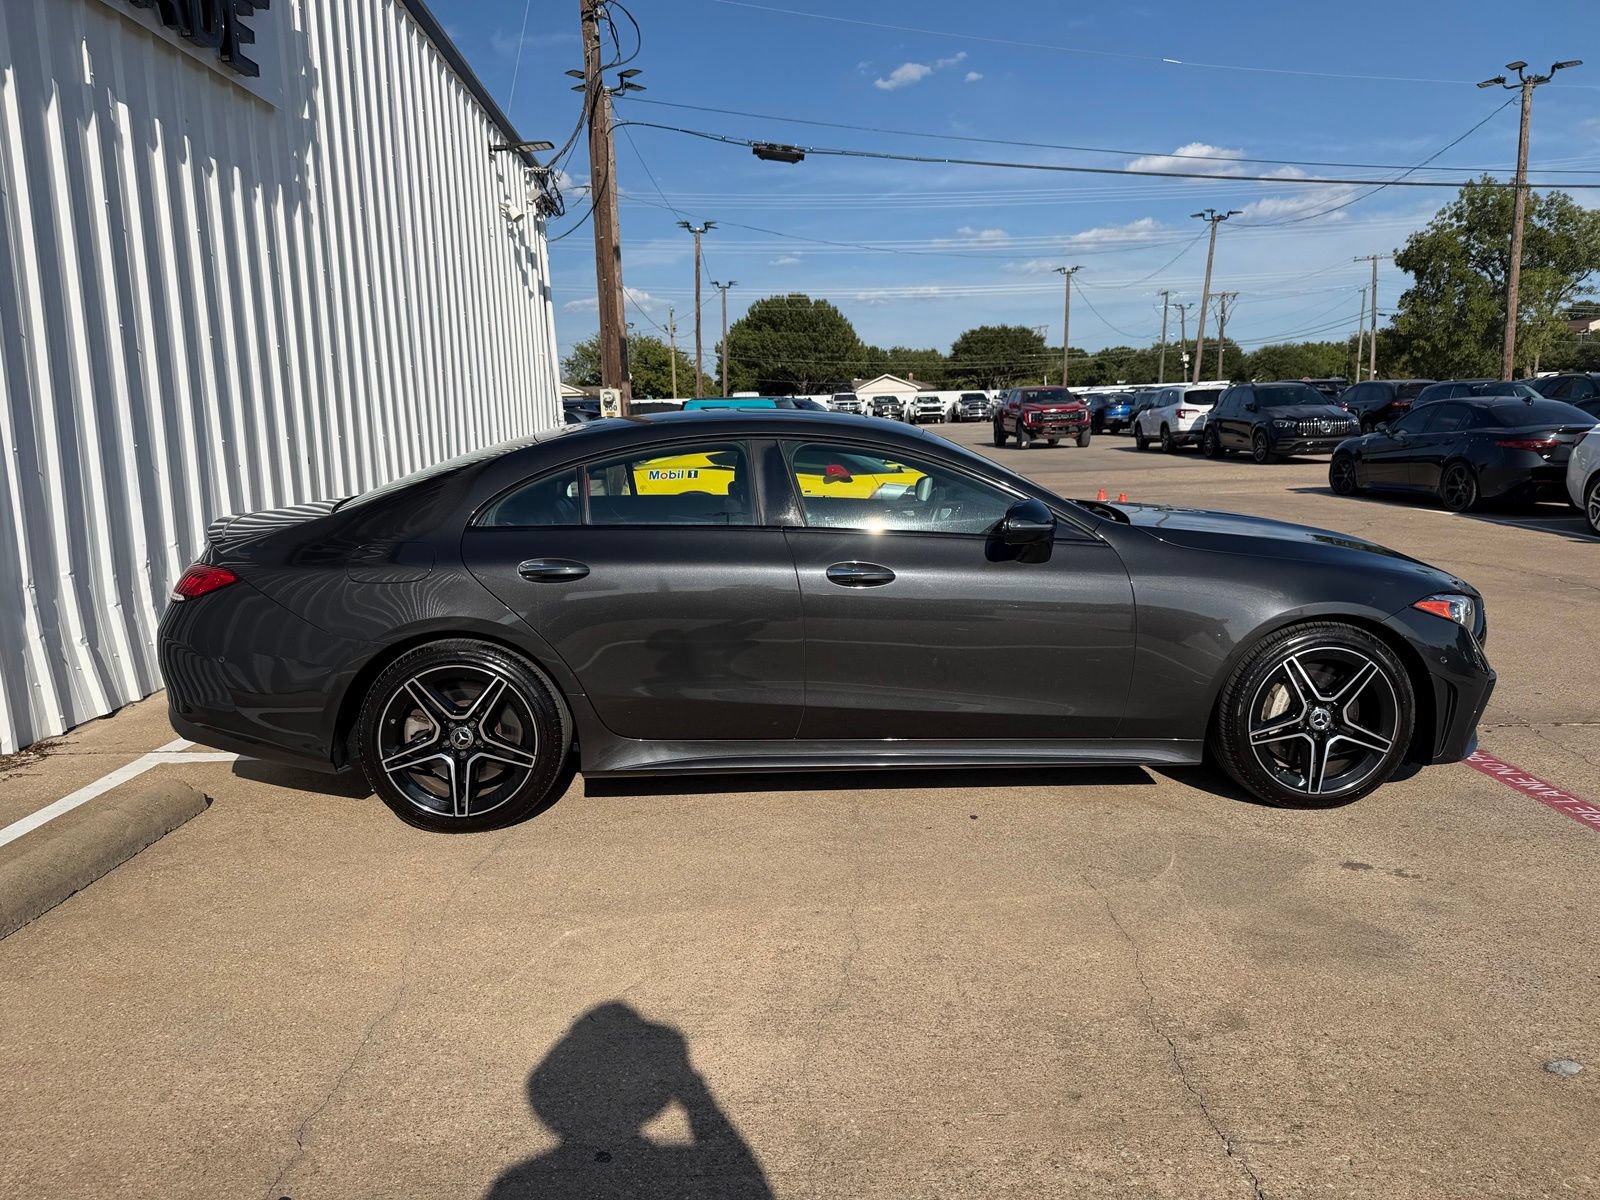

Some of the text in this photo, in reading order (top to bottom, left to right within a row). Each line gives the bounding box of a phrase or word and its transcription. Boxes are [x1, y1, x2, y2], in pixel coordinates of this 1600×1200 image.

[648, 470, 684, 480] Mobil
[1481, 762, 1521, 775] NO
[1506, 777, 1580, 803] LANE
